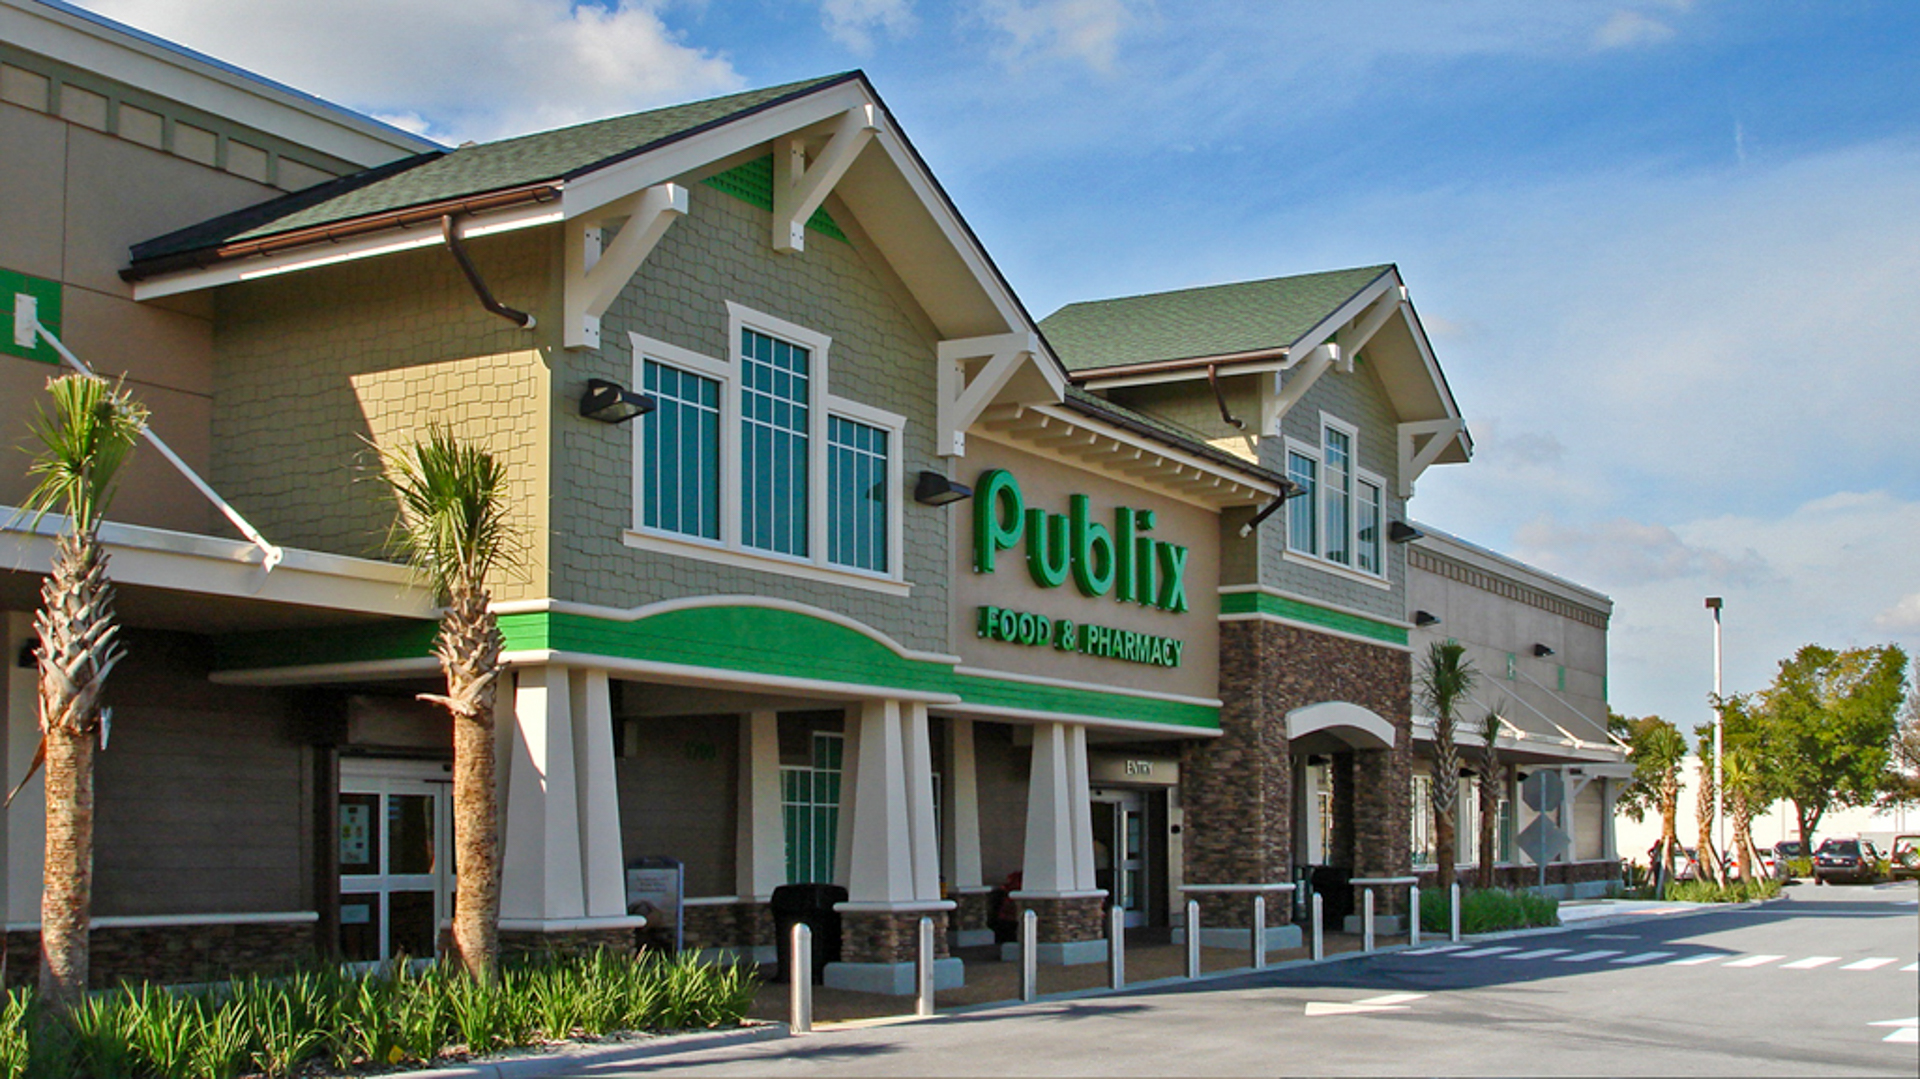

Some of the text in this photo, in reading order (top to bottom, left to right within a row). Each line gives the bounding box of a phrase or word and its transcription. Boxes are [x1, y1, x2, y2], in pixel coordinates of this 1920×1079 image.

[973, 468, 1188, 613] Publix
[977, 605, 1184, 668] FOOD & PHARMACY
[1126, 760, 1154, 775] ENTRY
